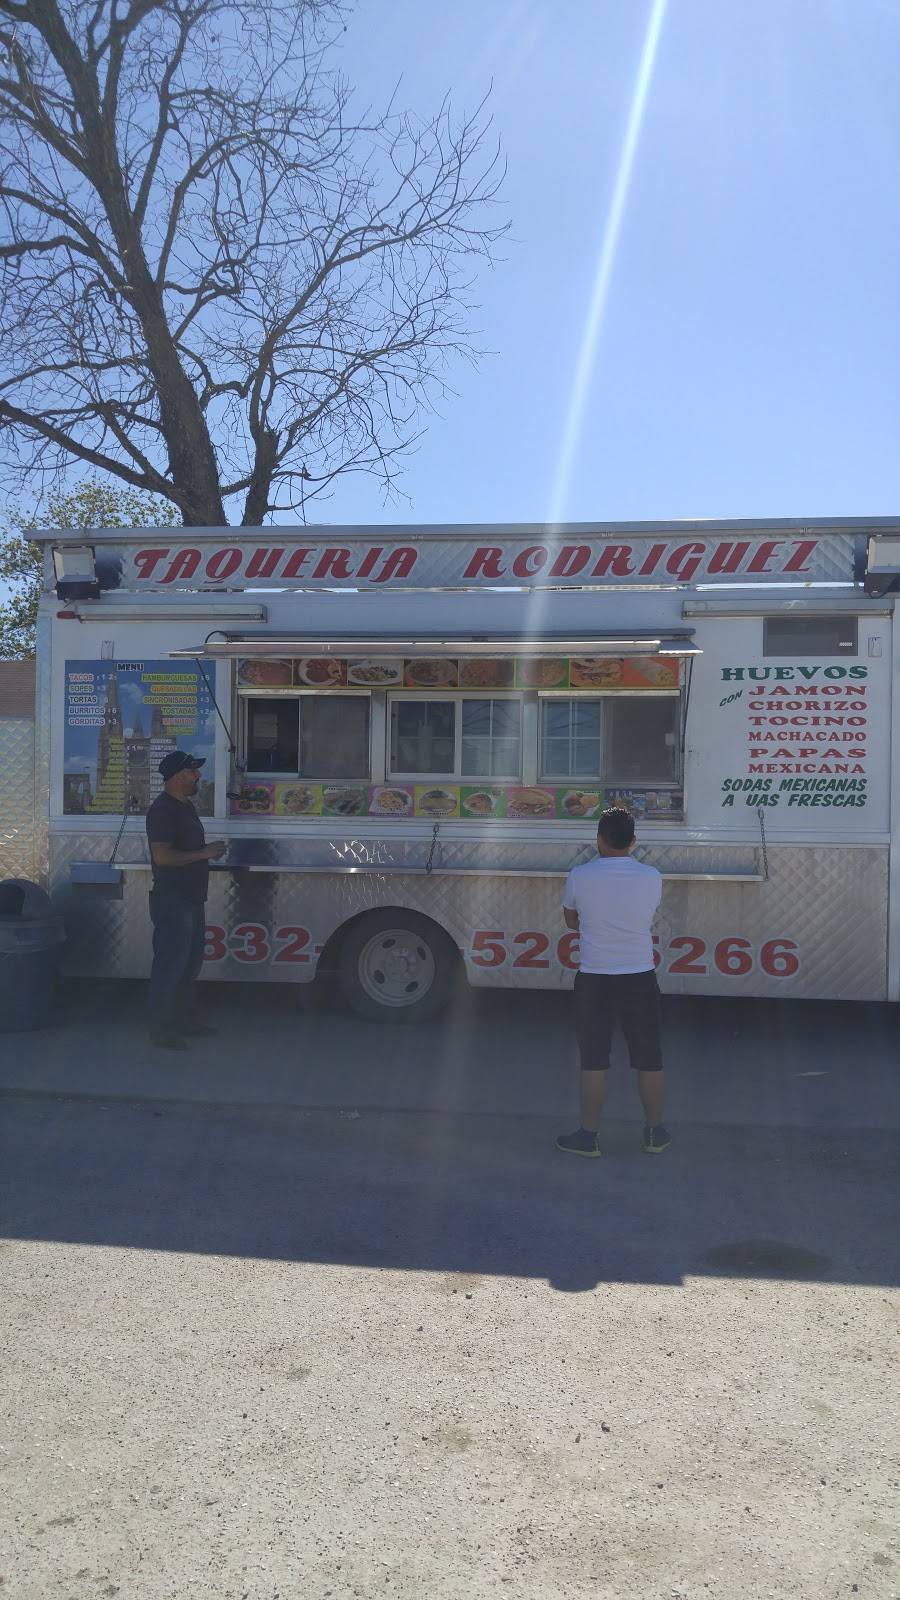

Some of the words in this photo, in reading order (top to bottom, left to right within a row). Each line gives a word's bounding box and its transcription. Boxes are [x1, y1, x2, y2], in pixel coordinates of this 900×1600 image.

[133, 546, 418, 584] TAQUERIA
[462, 540, 819, 582] RODRIGUEZ
[117, 663, 144, 672] MENU
[69, 674, 94, 682] TACOS
[721, 666, 868, 680] HUEVOS
[749, 686, 867, 696] JAMON
[69, 696, 97, 704] TORTAS
[719, 690, 743, 707] CON
[69, 707, 105, 715] BURRITOS
[749, 701, 867, 711] CHORIZO
[69, 718, 105, 726] GORDITAS
[749, 716, 867, 726] TOCINO
[749, 732, 867, 742] MACHACADO
[749, 748, 867, 759] PAPAS
[748, 763, 866, 774] MEXICANA
[721, 778, 772, 792] SODAS
[779, 778, 868, 792] MEXICANAS
[787, 793, 868, 807] FRESCAS
